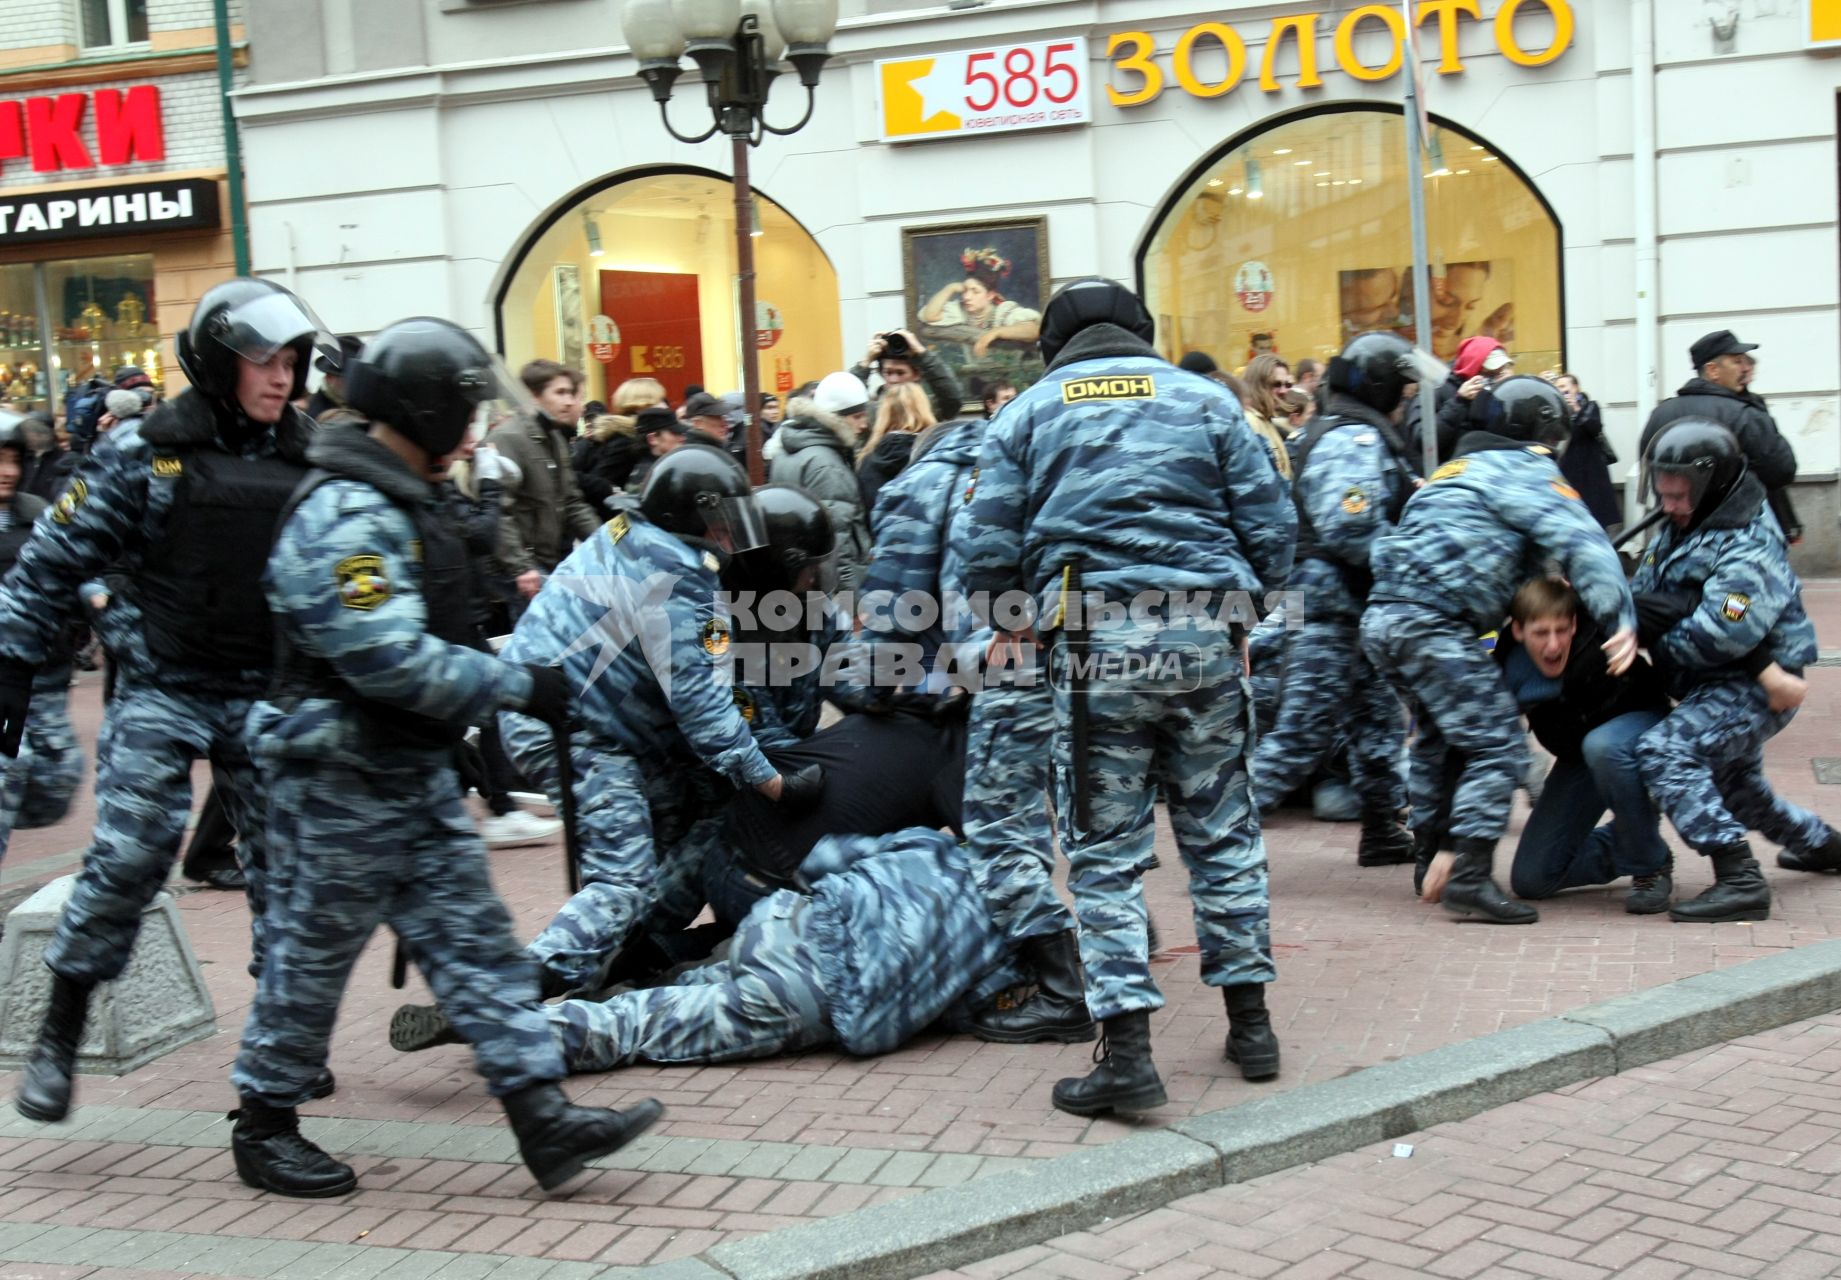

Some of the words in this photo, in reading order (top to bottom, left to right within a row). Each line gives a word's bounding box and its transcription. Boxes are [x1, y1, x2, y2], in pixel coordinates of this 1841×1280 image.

[1105, 0, 1575, 108] ЗОЛОТО
[964, 43, 1079, 112] 585
[1049, 109, 1083, 121] сеть
[652, 345, 684, 369] 585
[1067, 380, 1150, 398] ОМОН
